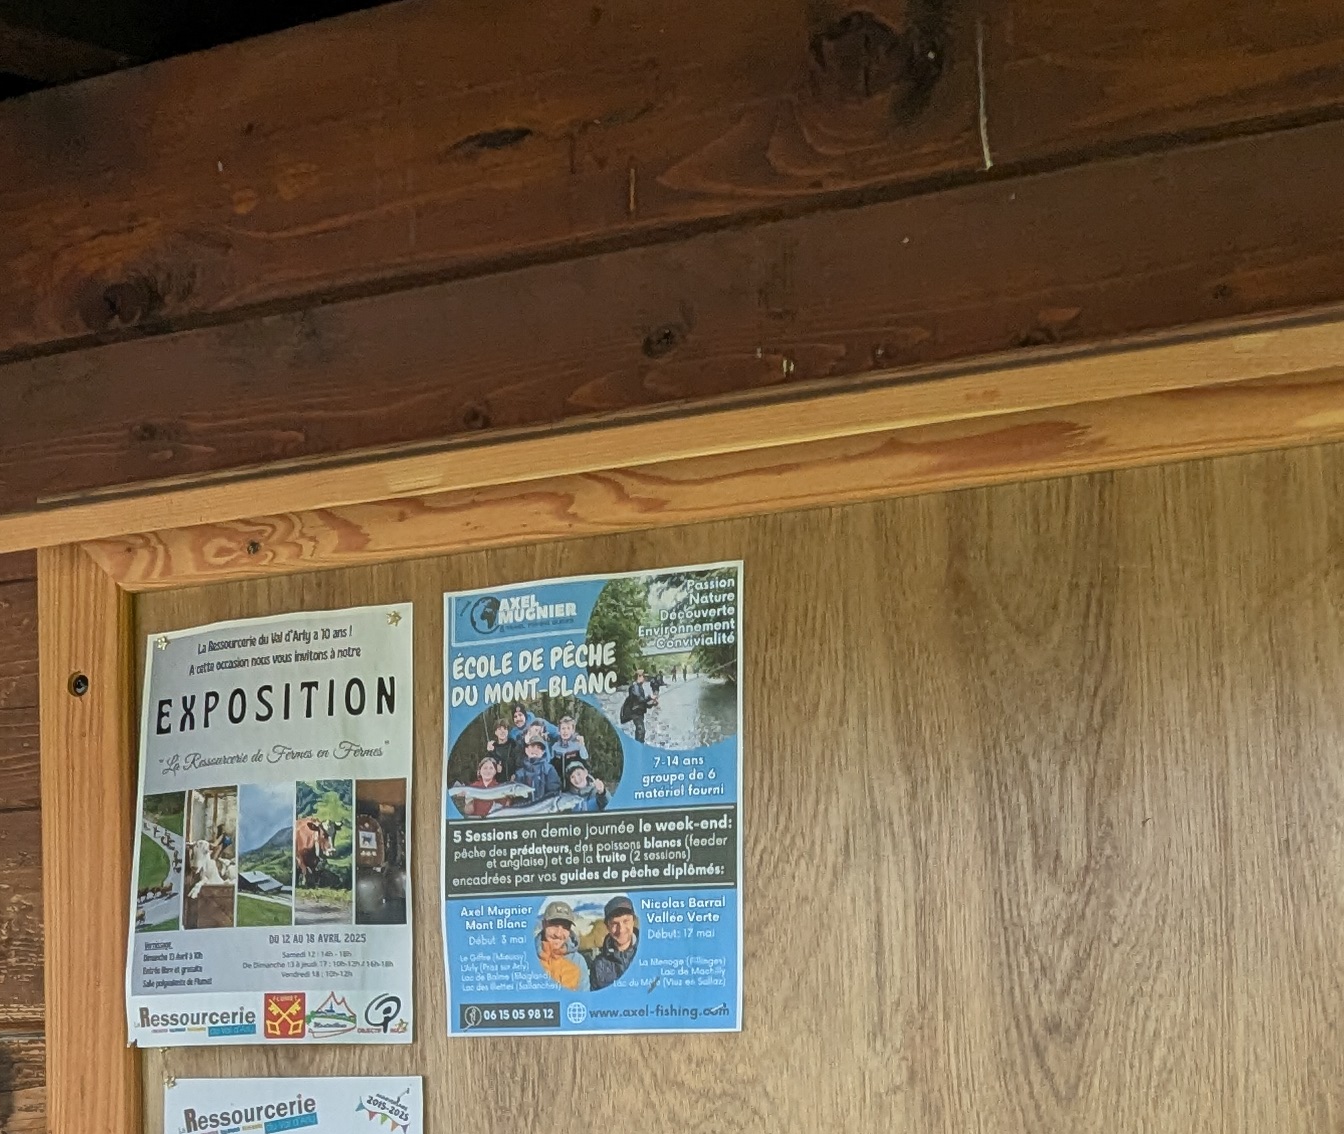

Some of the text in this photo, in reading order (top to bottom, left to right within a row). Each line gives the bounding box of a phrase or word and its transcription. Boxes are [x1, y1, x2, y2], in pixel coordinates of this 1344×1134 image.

[687, 577, 734, 590] Passion
[499, 594, 539, 611] AXEL
[689, 592, 735, 605] Nature
[498, 602, 577, 625] MUGNIER
[660, 604, 735, 621] Découverte
[638, 618, 735, 637] Environnement
[198, 643, 207, 655] La
[208, 635, 257, 652] Ressourcerie
[258, 633, 269, 645] du
[271, 631, 283, 644] Val
[313, 631, 319, 641] a
[321, 628, 331, 640] 10
[333, 628, 347, 639] ans
[656, 631, 735, 648] Convivialité
[189, 646, 362, 676] A cette occasion nous vous invitons à notre
[452, 640, 616, 680] ÉCOLE DE PÊCHE
[451, 671, 618, 707] DU MONT-BLANC
[156, 676, 396, 735] EXPOSITION
[251, 749, 263, 763] de
[266, 744, 313, 764] Fermes
[317, 749, 329, 759] en
[653, 755, 704, 768] 7-14 ans
[642, 768, 716, 787] groupe de 6
[634, 783, 724, 799] matériel fourni
[453, 813, 733, 843] 5 Sessions en demie journée le week-end:
[454, 845, 487, 862] pêche
[489, 845, 507, 858] des
[574, 839, 593, 853] des
[596, 840, 641, 854] poissons
[643, 836, 682, 850] blancs
[684, 832, 728, 850] (feeder
[486, 847, 691, 871] et anglaise) et de la truite (2 sessions)
[452, 871, 512, 887] encadrées
[514, 874, 535, 887] par
[538, 872, 557, 882] vos
[560, 867, 600, 885] guides
[602, 866, 619, 880] de
[621, 864, 660, 882] pêche
[641, 895, 726, 910] Nicolas Barral
[460, 904, 533, 919] Axel Mugnier
[646, 910, 720, 923] Vallée Verte
[465, 918, 528, 930] Mont Blanc
[269, 934, 279, 945] DU
[282, 934, 290, 944] 12
[293, 934, 304, 944] AU
[318, 933, 341, 944] AVRIL
[344, 933, 367, 943] 2025
[509, 934, 527, 944] mai
[683, 928, 694, 938] 17
[696, 929, 715, 938] mai
[242, 961, 286, 969] De Dimanche
[660, 966, 689, 976] Lac de
[139, 1006, 256, 1028] Ressourcerie
[483, 1008, 555, 1021] 06 15 05 98 12
[184, 1093, 317, 1133] Ressourcerie
[366, 1095, 410, 1122] 2015-2025
